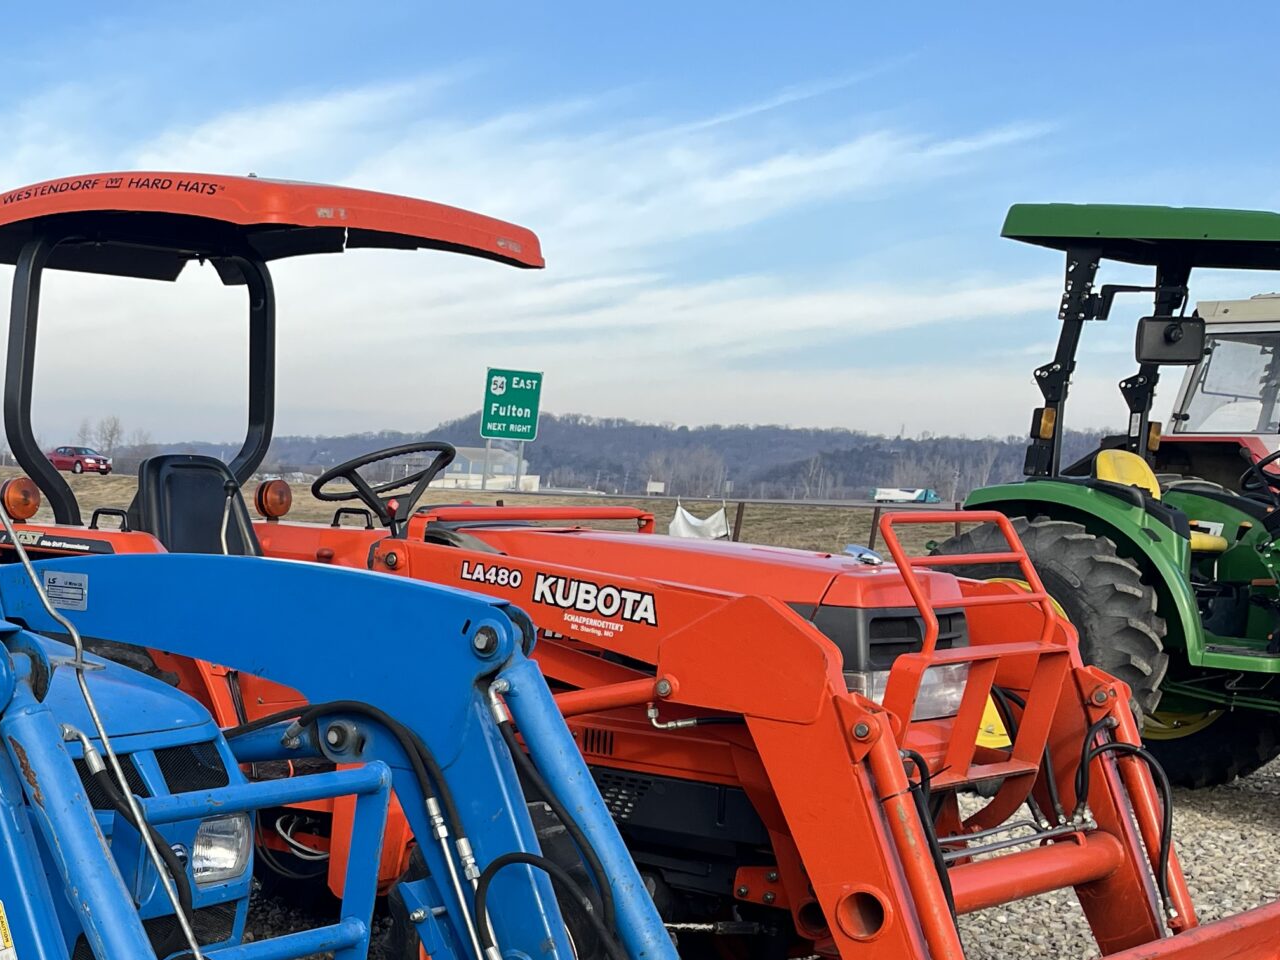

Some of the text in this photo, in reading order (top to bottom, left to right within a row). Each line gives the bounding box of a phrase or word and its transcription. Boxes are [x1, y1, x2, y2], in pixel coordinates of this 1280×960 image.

[3, 178, 100, 204] WESTENDORF
[127, 177, 173, 191] HARD
[492, 377, 538, 391] 54 EAST
[491, 403, 531, 418] Fulton
[487, 422, 532, 434] NEXT RIGHT
[461, 561, 523, 588] LA480
[532, 573, 658, 626] KUBOTA
[604, 630, 614, 638] MO
[0, 915, 10, 943] CAUTION
